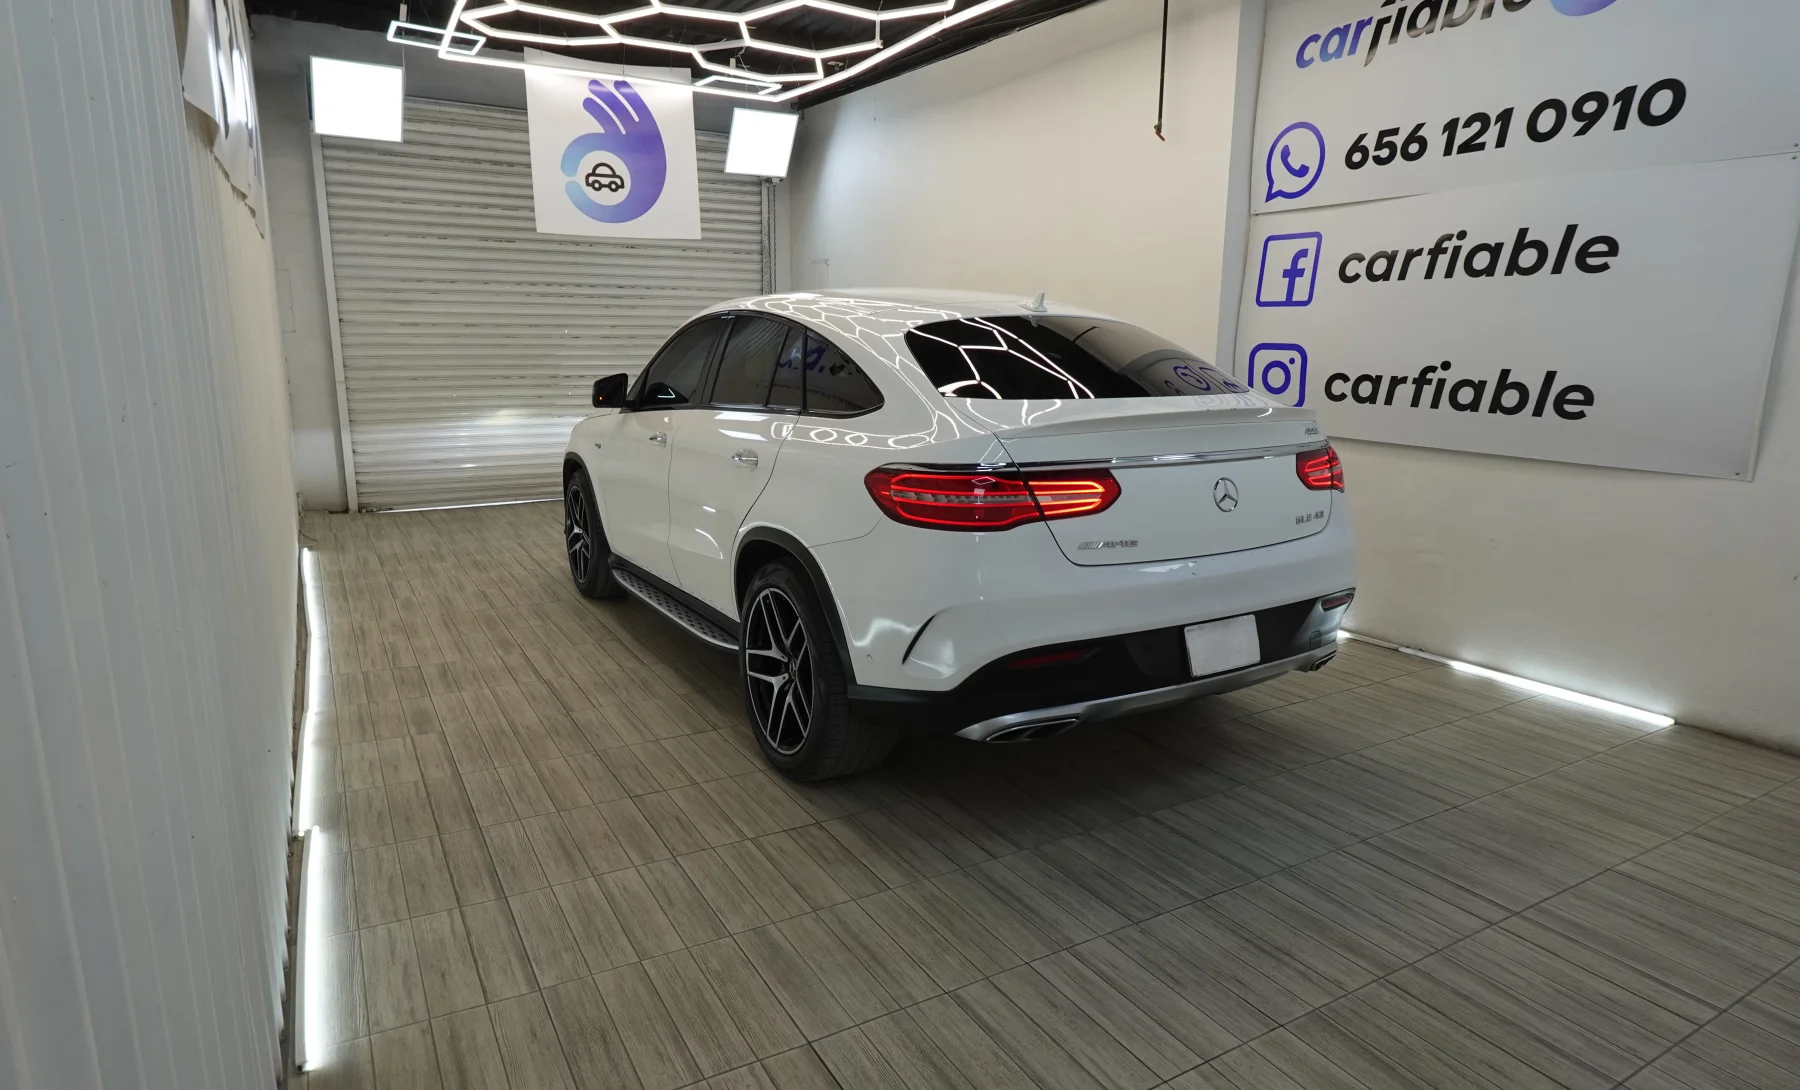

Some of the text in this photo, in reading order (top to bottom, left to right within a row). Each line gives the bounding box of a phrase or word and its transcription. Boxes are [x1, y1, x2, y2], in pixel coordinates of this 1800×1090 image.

[1344, 77, 1687, 170] 656 121 0910
[1338, 223, 1620, 284] carfiable
[1324, 360, 1595, 421] carfiable
